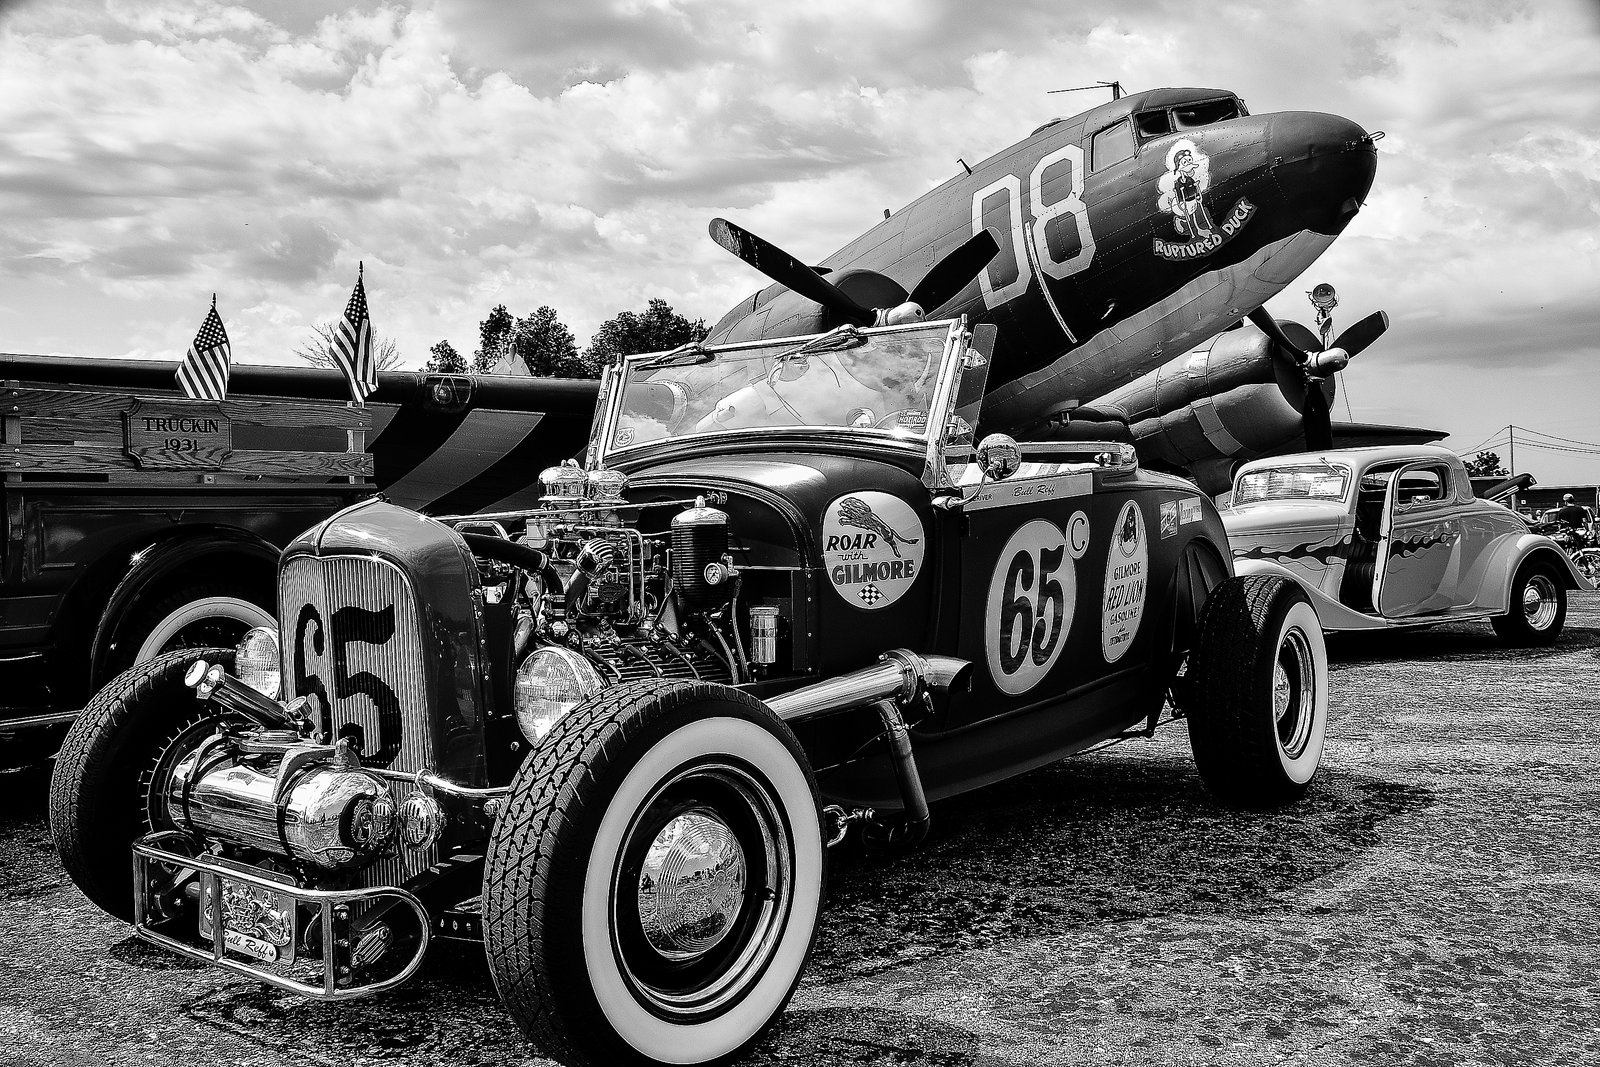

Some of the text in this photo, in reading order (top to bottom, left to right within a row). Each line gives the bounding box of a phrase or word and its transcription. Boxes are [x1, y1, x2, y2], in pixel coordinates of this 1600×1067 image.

[1155, 200, 1253, 257] RUPTURED DUCK
[142, 417, 219, 433] TRUCKIN
[164, 439, 198, 451] 1931
[826, 533, 877, 551] ROAR
[1071, 517, 1086, 552] C
[838, 551, 868, 561] with
[832, 560, 915, 585] GILMORE
[1113, 561, 1141, 580] GILMORE
[1104, 578, 1145, 612] RED LION
[1000, 543, 1066, 675] 65
[294, 603, 402, 769] 65
